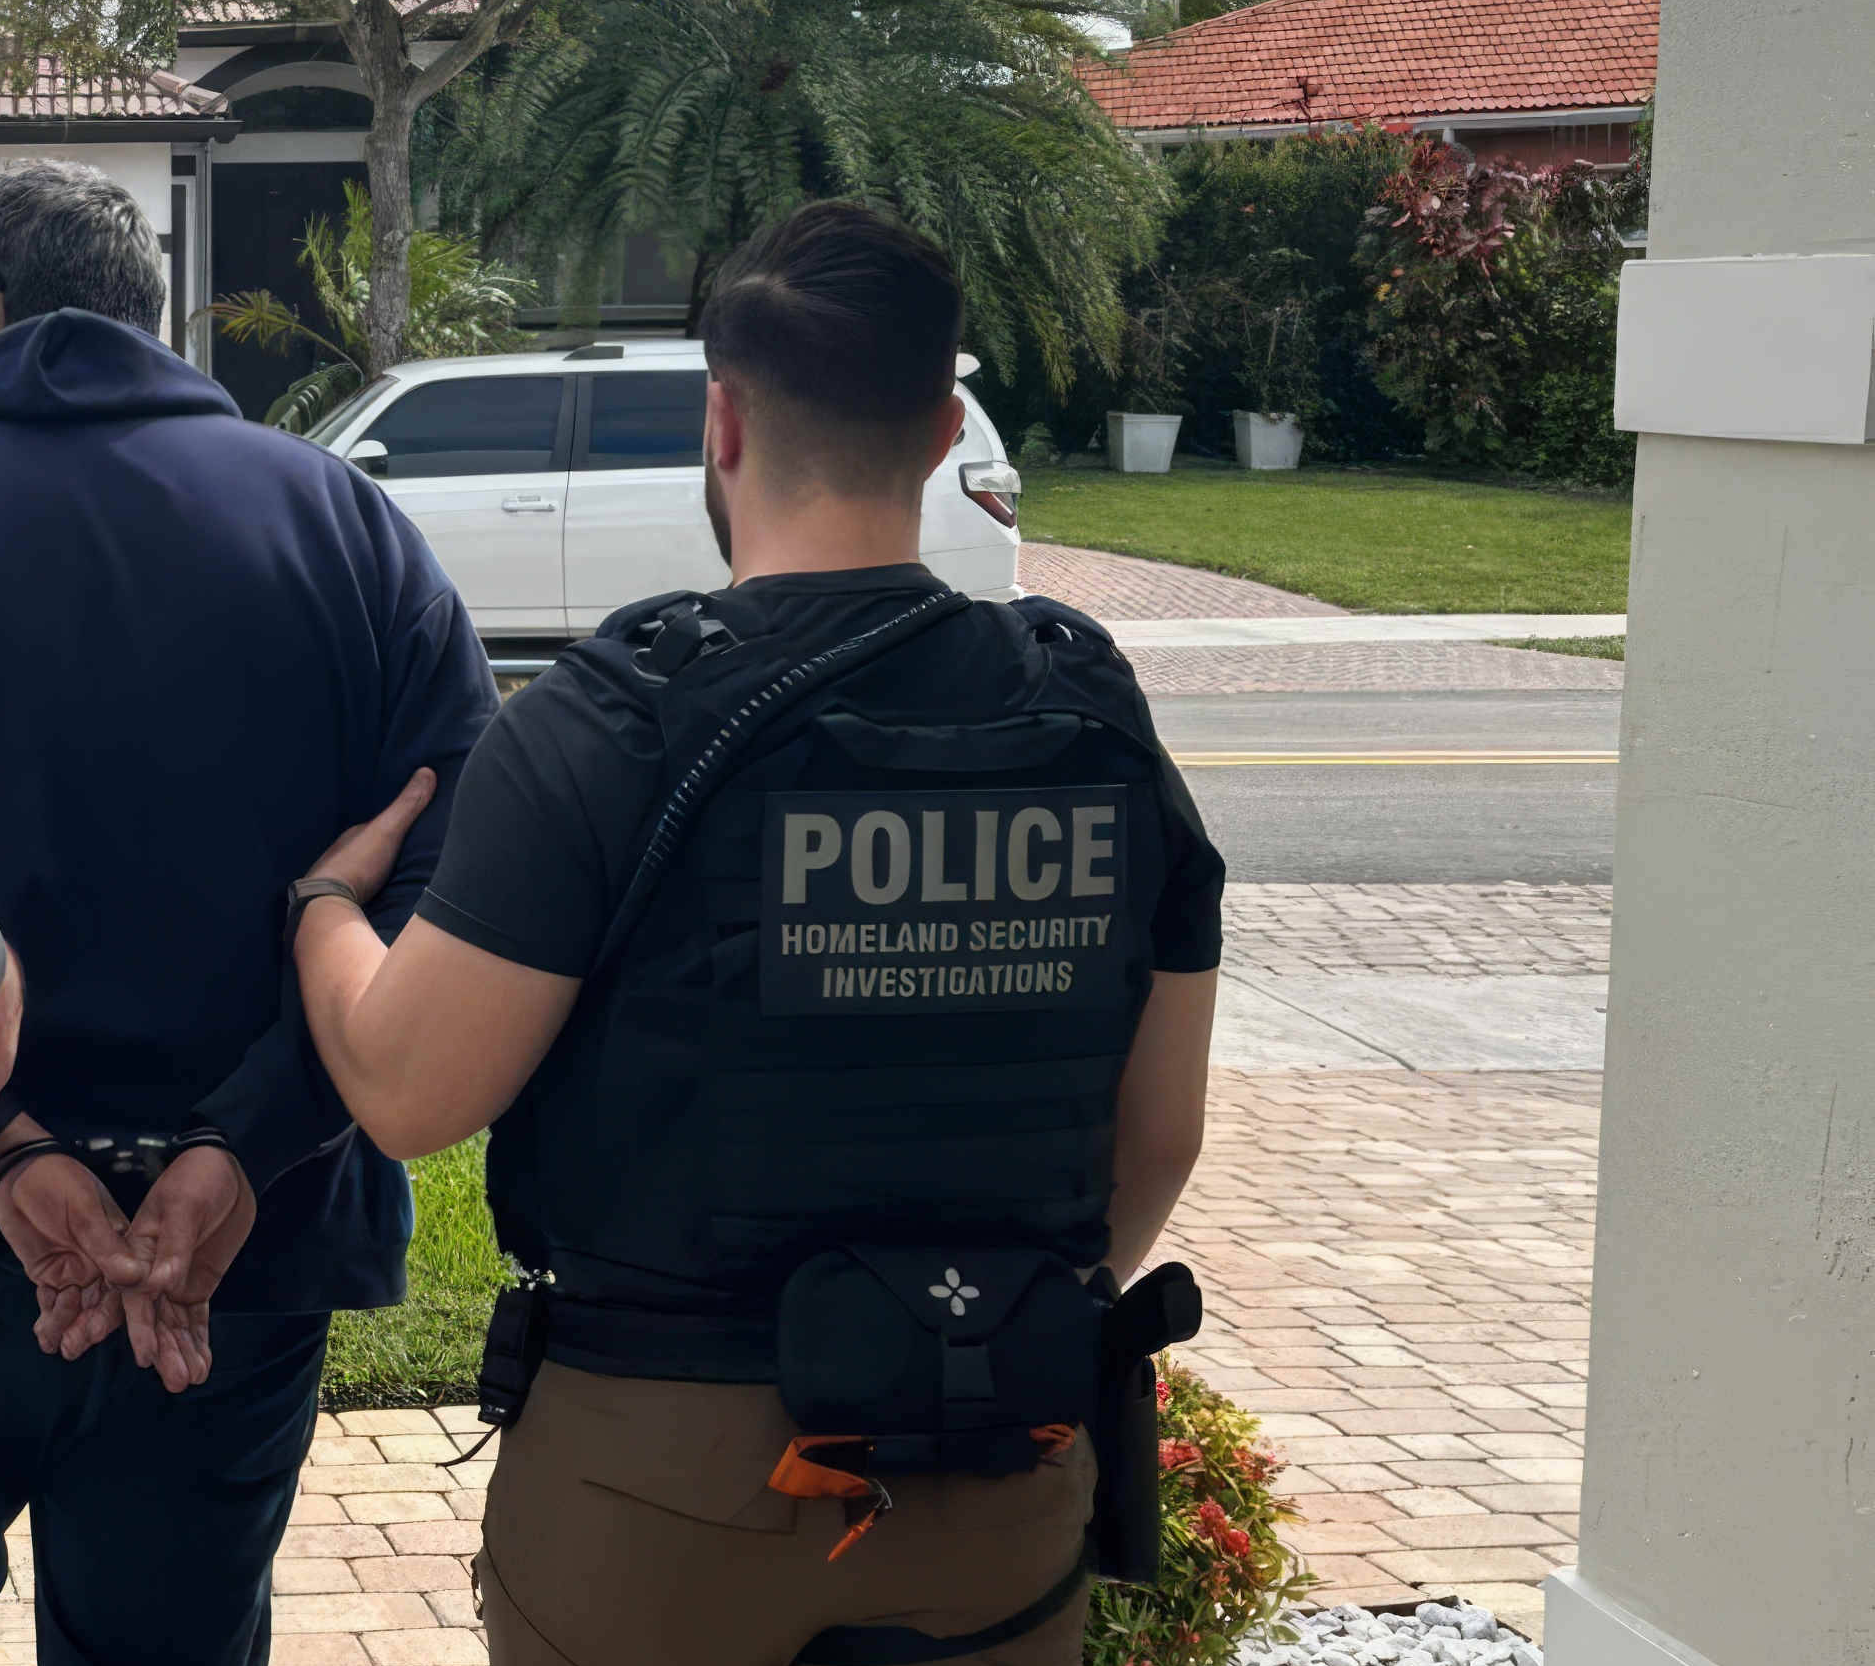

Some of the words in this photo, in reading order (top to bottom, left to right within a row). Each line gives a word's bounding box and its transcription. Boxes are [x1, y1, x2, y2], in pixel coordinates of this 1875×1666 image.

[781, 804, 1117, 906] POLICE
[781, 922, 959, 955] HOMELAND
[968, 914, 1112, 952] SECURITY
[821, 960, 1074, 998] INVESTIGATIONS
